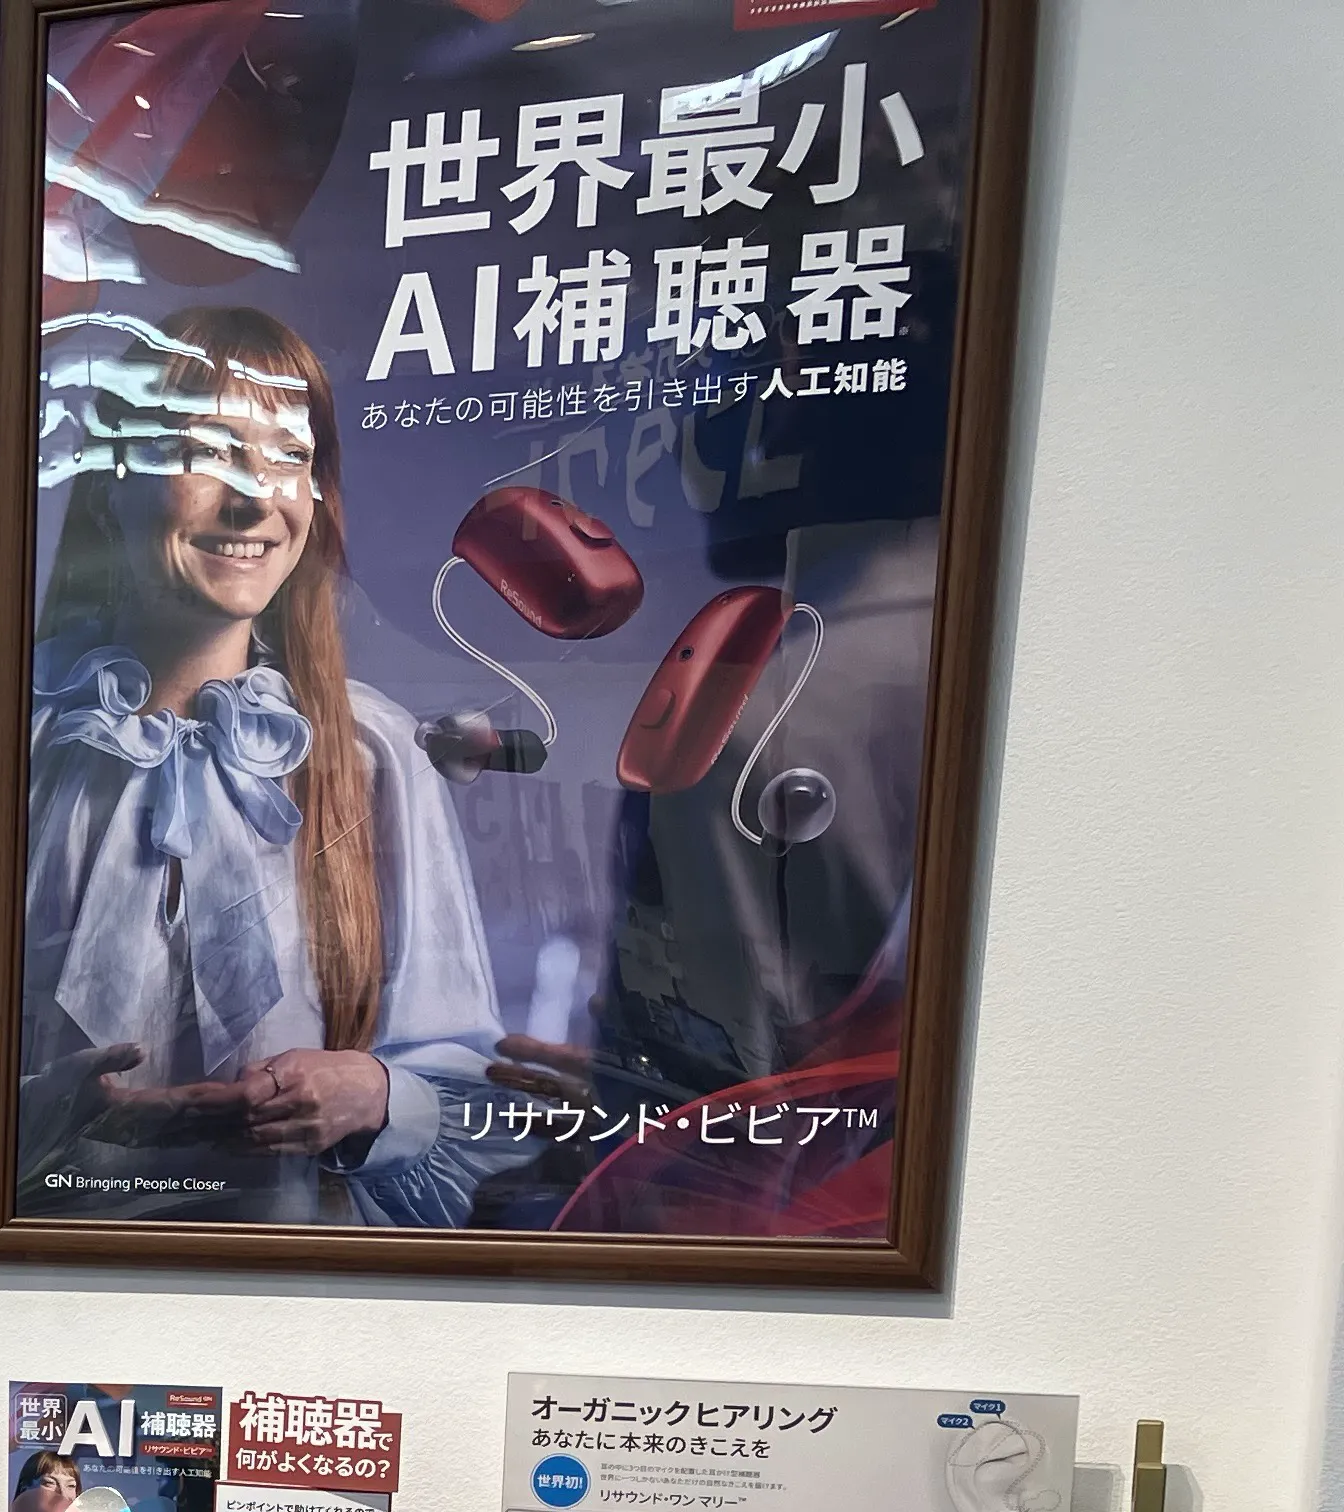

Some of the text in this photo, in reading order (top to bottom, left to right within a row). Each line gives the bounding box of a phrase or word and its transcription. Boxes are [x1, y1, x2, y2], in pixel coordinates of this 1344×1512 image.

[368, 60, 928, 250] 世界最小
[364, 223, 914, 383] AI補聴器
[360, 356, 910, 432] あなたの可能性を引き出す人工知能
[44, 1173, 227, 1193] GN Bringing People Closer
[19, 1396, 63, 1419] 世界
[239, 1394, 395, 1451] 補聴器で
[18, 1420, 62, 1442] 最小
[56, 1398, 218, 1458] AI 補聴器
[530, 1428, 772, 1460] あなたに本来のきこえを
[235, 1446, 391, 1480] 何がよくなるの？
[537, 1474, 584, 1491] 世界初！
[599, 1489, 696, 1506] リサウンド・ワン
